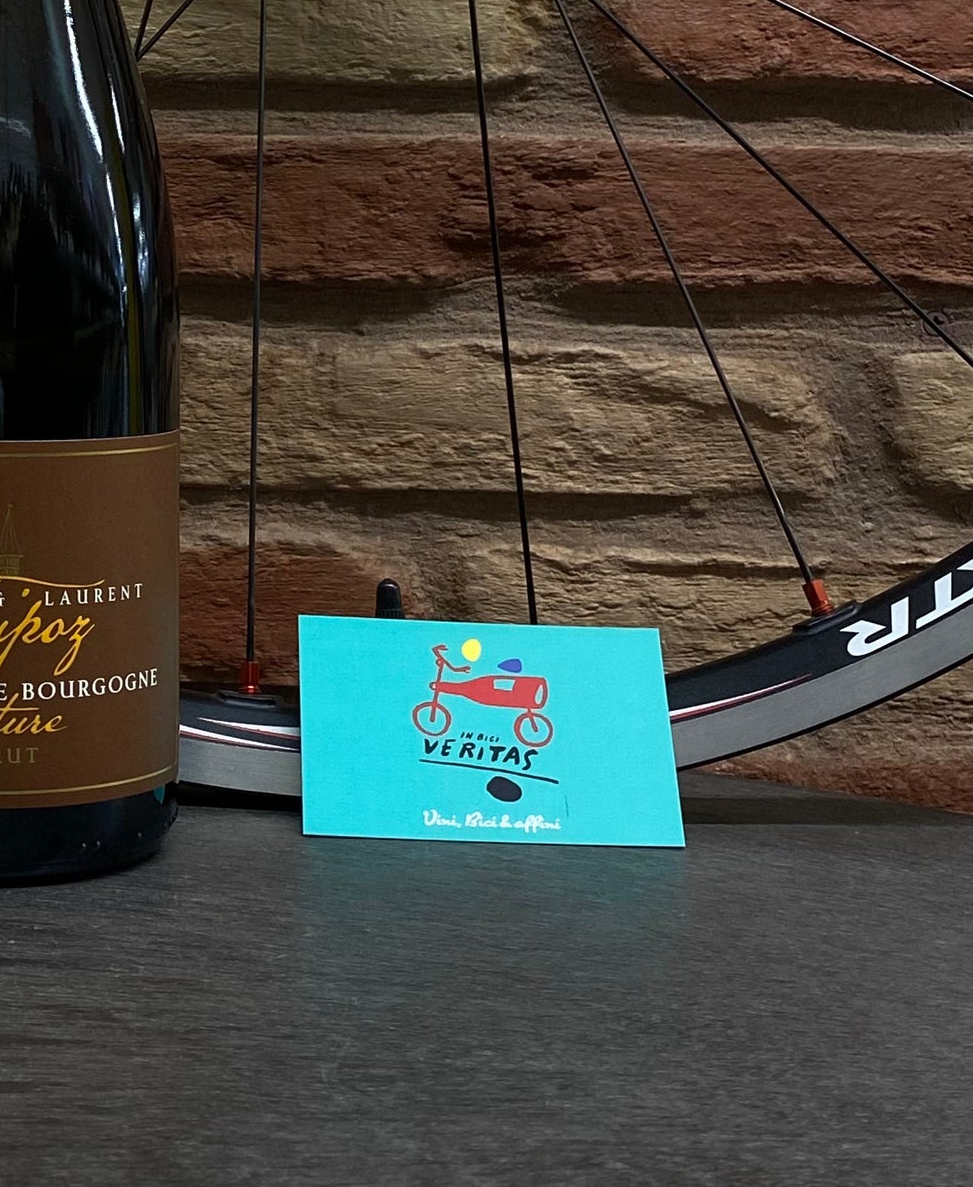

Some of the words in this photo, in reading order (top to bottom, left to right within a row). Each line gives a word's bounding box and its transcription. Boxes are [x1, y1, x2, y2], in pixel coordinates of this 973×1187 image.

[44, 583, 144, 607] LAURENT
[839, 559, 973, 657] TR
[21, 668, 159, 701] BOURGOGNE
[460, 732, 474, 740] IN
[476, 733, 500, 743] BICI
[424, 738, 539, 771] VERITAS
[422, 809, 462, 829] Vini,
[464, 811, 498, 829] Bici
[513, 814, 562, 833] affini
